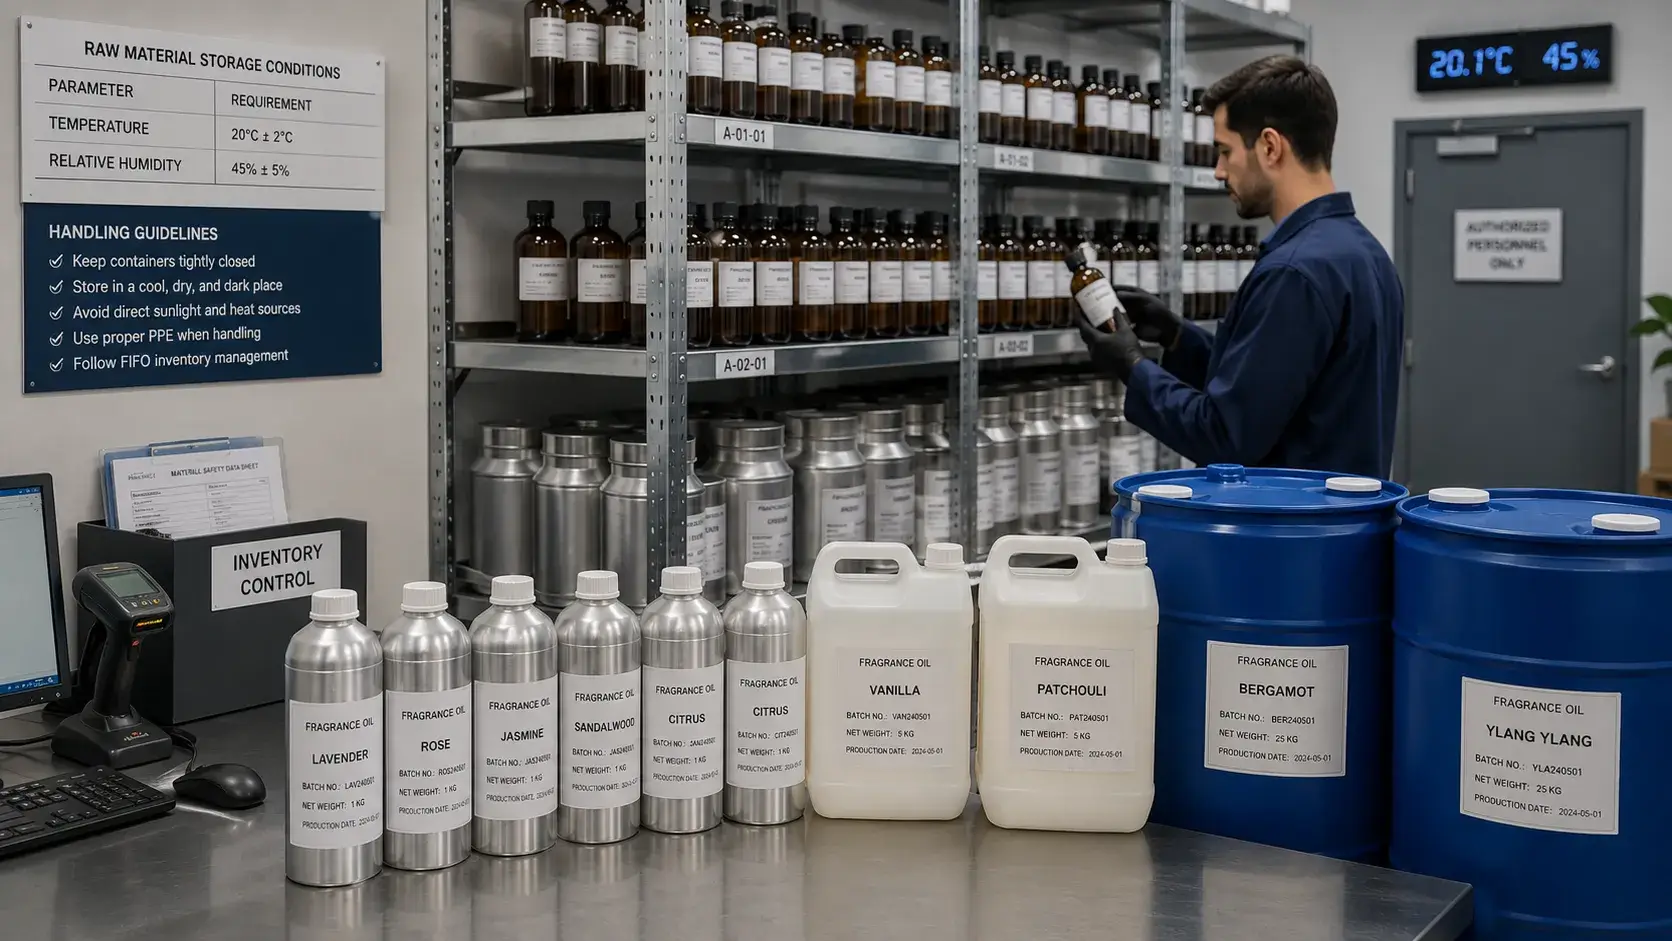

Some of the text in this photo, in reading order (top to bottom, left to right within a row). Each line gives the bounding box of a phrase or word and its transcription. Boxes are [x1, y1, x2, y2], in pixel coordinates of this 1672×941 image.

[84, 41, 341, 80] RAW MATERIAL STORAGE CONDITIONS
[1430, 46, 1514, 79] 20.1°C
[49, 78, 134, 98] PARAMETER
[231, 94, 312, 112] REQUIREMENT
[49, 116, 149, 135] TEMPERATURE
[231, 128, 259, 143] 20°C
[273, 130, 293, 144] 2°C
[723, 126, 766, 143] A-01-01
[49, 154, 182, 172] RELATIVE HUMIDITY
[231, 162, 257, 176] 45%
[272, 163, 290, 178] 5%
[49, 224, 218, 242] HANDLING GUIDELINES
[1465, 220, 1550, 234] AUTHORIZED
[1467, 239, 1548, 252] PERSONNEL
[73, 254, 256, 270] Keep containers tightly closed
[1489, 257, 1525, 270] ONLY
[73, 279, 283, 295] Store in a cool, dry, and dark place
[73, 303, 301, 320] Avoid direct sunlight and heat sources
[73, 327, 261, 347] Use proper PPE when handling
[73, 350, 289, 370] Follow FIFO inventory management
[724, 356, 767, 373] A-02-01
[203, 465, 225, 475] SAFETY
[233, 544, 323, 571] INVENTORY
[240, 571, 315, 595] CONTROL
[859, 658, 931, 668] FRAGRANCE OIL
[1035, 657, 1110, 668] FRAGRANCE OIL
[1237, 656, 1317, 668] FRAGRANCE OIL
[656, 685, 704, 696] FRAGRANCE
[740, 678, 788, 689] FRAGRANCE
[870, 685, 921, 696] VANILLA
[1037, 684, 1107, 697] PATCHOULI
[1239, 683, 1315, 698] BERGAMOT
[575, 691, 624, 702] FRAGRANCE
[401, 705, 466, 720] FRAGRANCE OIL
[489, 700, 539, 711] FRAGRANCE
[753, 706, 789, 717] CITRUS
[1493, 696, 1584, 715] FRAGRANCE OIL
[669, 713, 706, 724] CITRUS
[846, 712, 870, 720] BATCH
[892, 713, 931, 721] VAN240501
[1020, 712, 1109, 722] BATCH NO.: PAT240501
[1219, 710, 1315, 725] BATCH NO.: BER240501
[305, 717, 374, 732] FRAGRANCE OIL
[574, 717, 635, 732] SANDALWOOD
[500, 728, 544, 742] JASMINE
[846, 729, 861, 737] NET
[862, 729, 893, 738] WEIGHT:
[904, 730, 915, 738] KG
[1020, 729, 1035, 738] NET
[1036, 730, 1068, 739] WEIGHT:
[1080, 732, 1091, 740] KG
[1219, 729, 1299, 743] NET WEIGHT: 25 KG
[1486, 724, 1592, 748] YLANG YLANG
[421, 739, 451, 752] ROSE
[846, 746, 888, 755] PRODUCTION
[889, 747, 907, 755] DATE:
[1020, 748, 1063, 758] PRODUCTION
[1064, 750, 1084, 758] DATE:
[312, 749, 369, 765] LAVENDER
[487, 758, 507, 766] BATCH
[1218, 747, 1332, 763] PRODUCTION DATE: 2024-05-01
[1475, 754, 1582, 776] BATCH NO.: YLA240501
[399, 769, 420, 777] BATCH
[302, 782, 325, 791] BATCH
[399, 788, 411, 796] NET
[1474, 774, 1562, 795] NET WEIGHT: 25 KG
[302, 802, 315, 810] NET
[317, 802, 347, 810] WEIGHT:
[1474, 794, 1602, 818] PRODUCTION DATE: 2024-05-01
